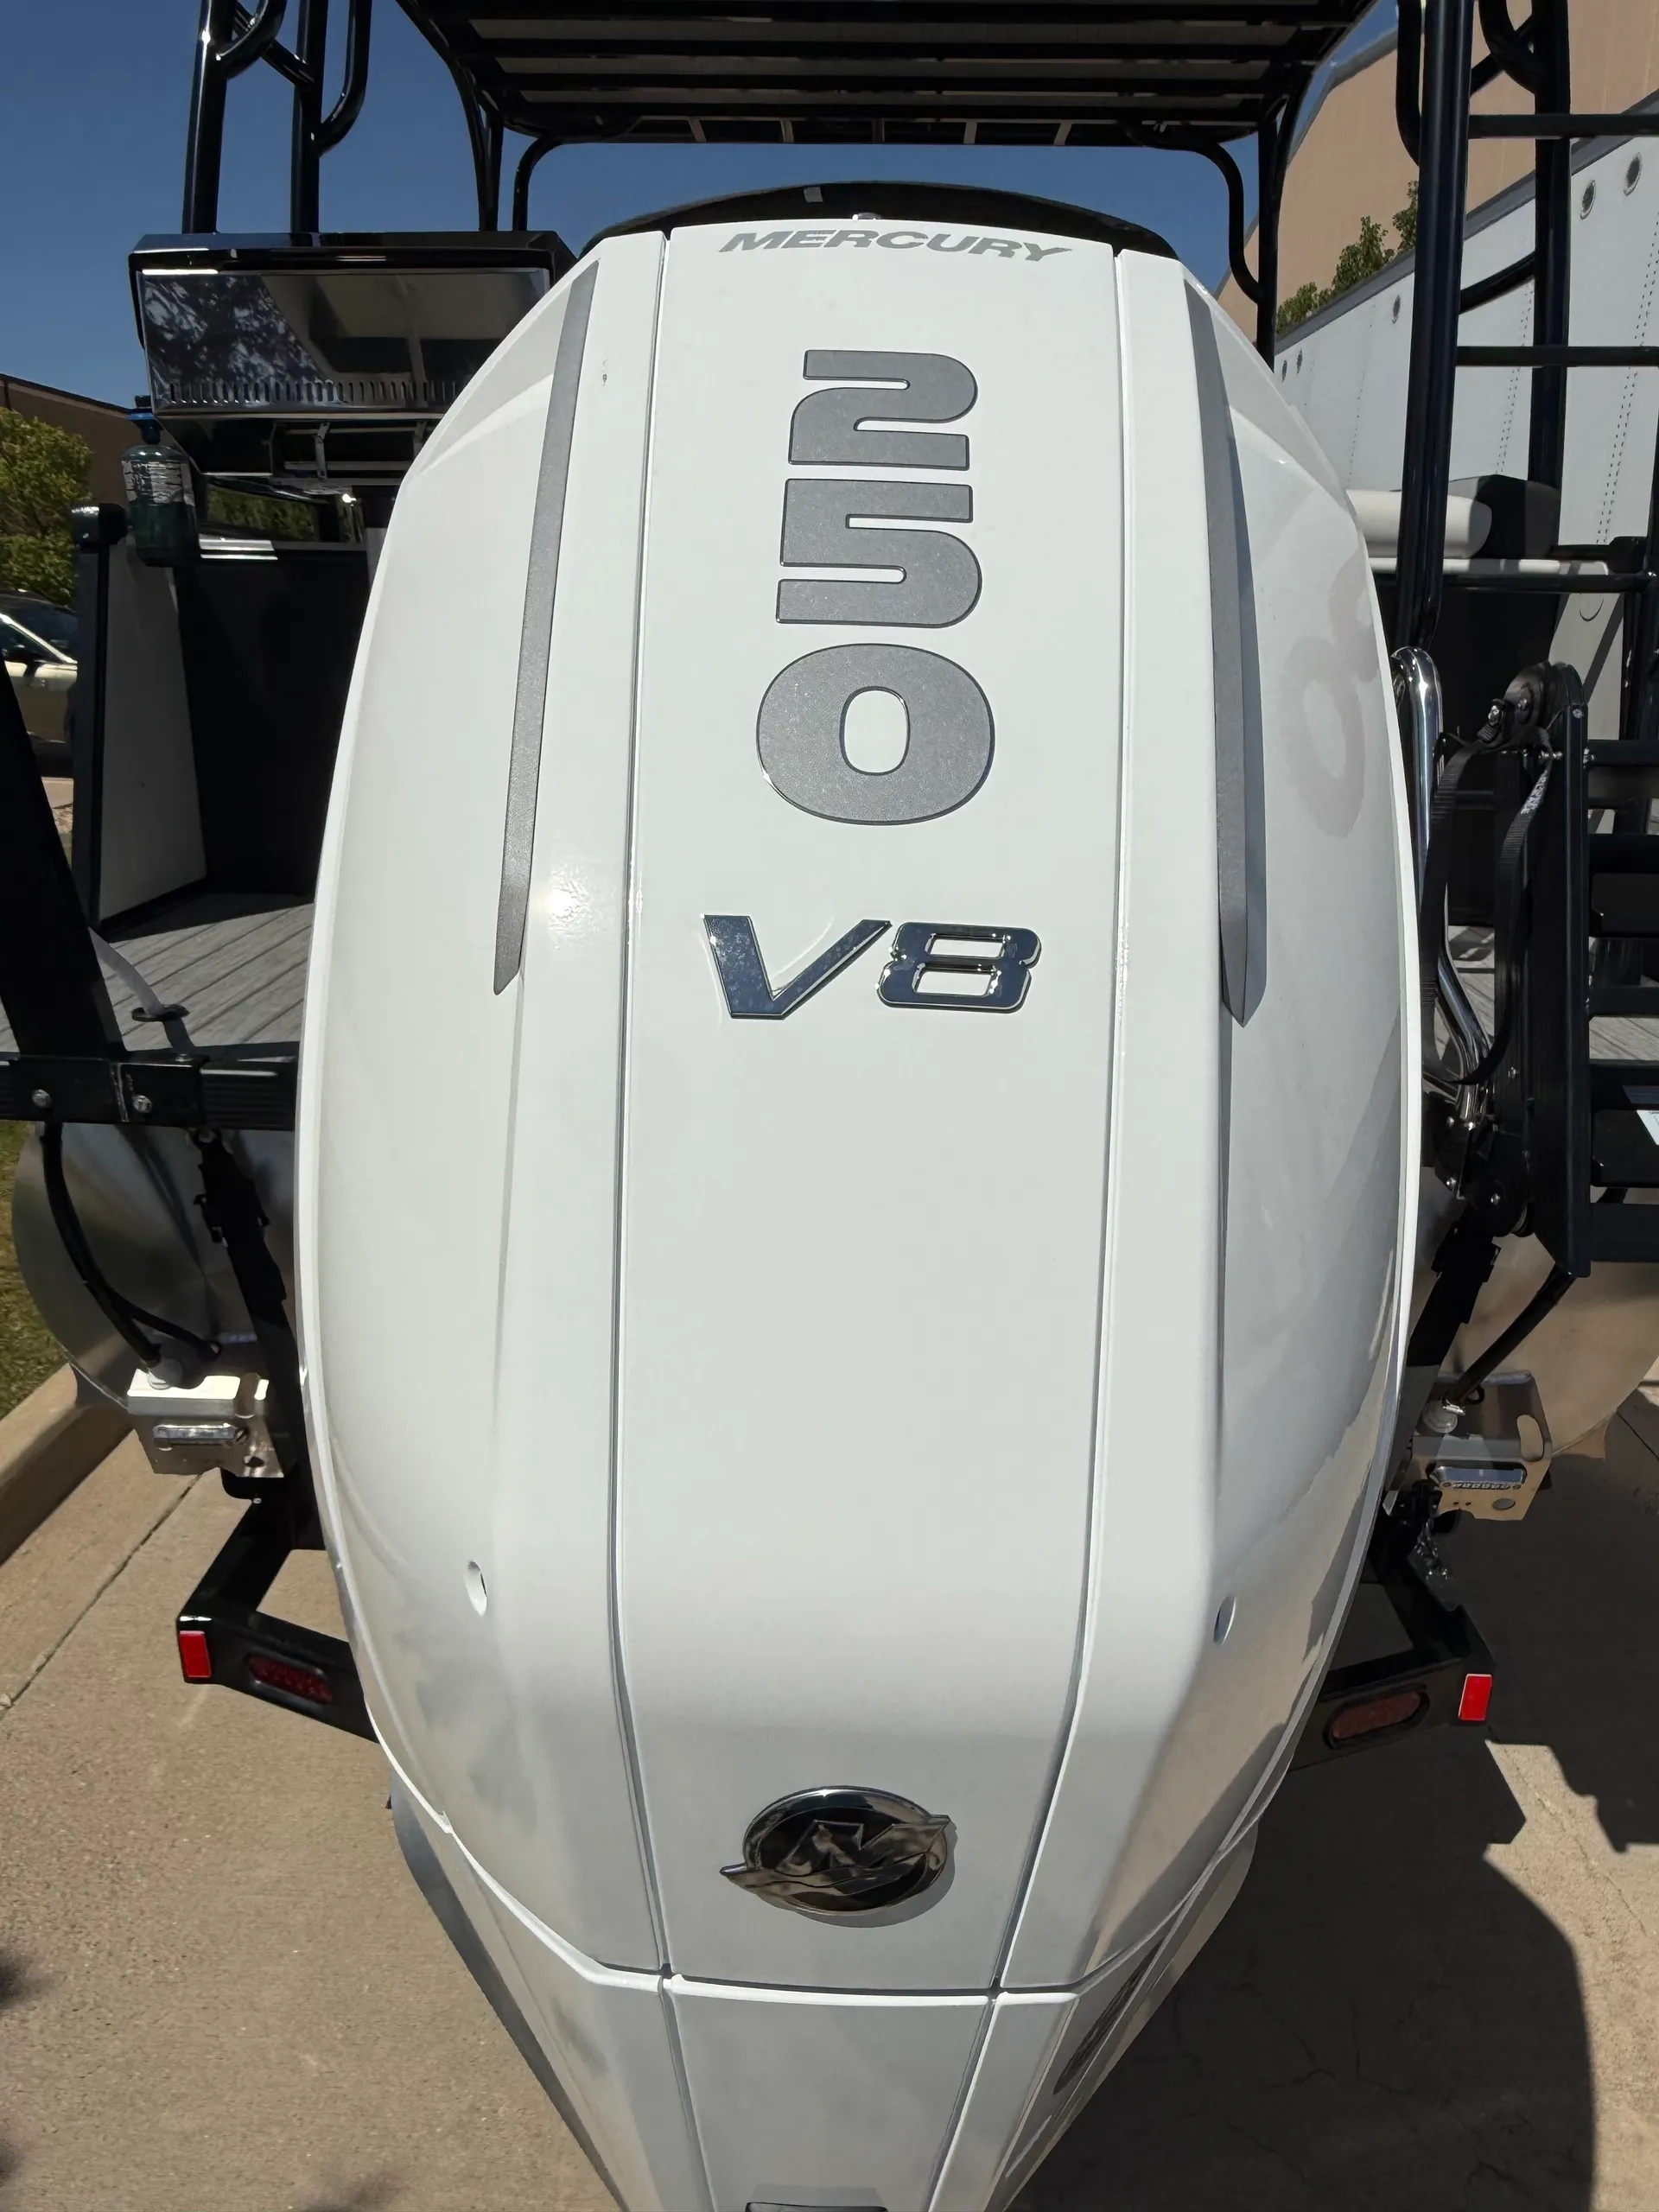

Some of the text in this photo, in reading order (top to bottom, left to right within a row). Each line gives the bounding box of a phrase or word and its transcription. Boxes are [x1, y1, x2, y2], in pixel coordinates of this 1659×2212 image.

[718, 229, 1072, 261] MERCURY
[756, 349, 995, 825] 250
[702, 914, 1042, 1020] V8
